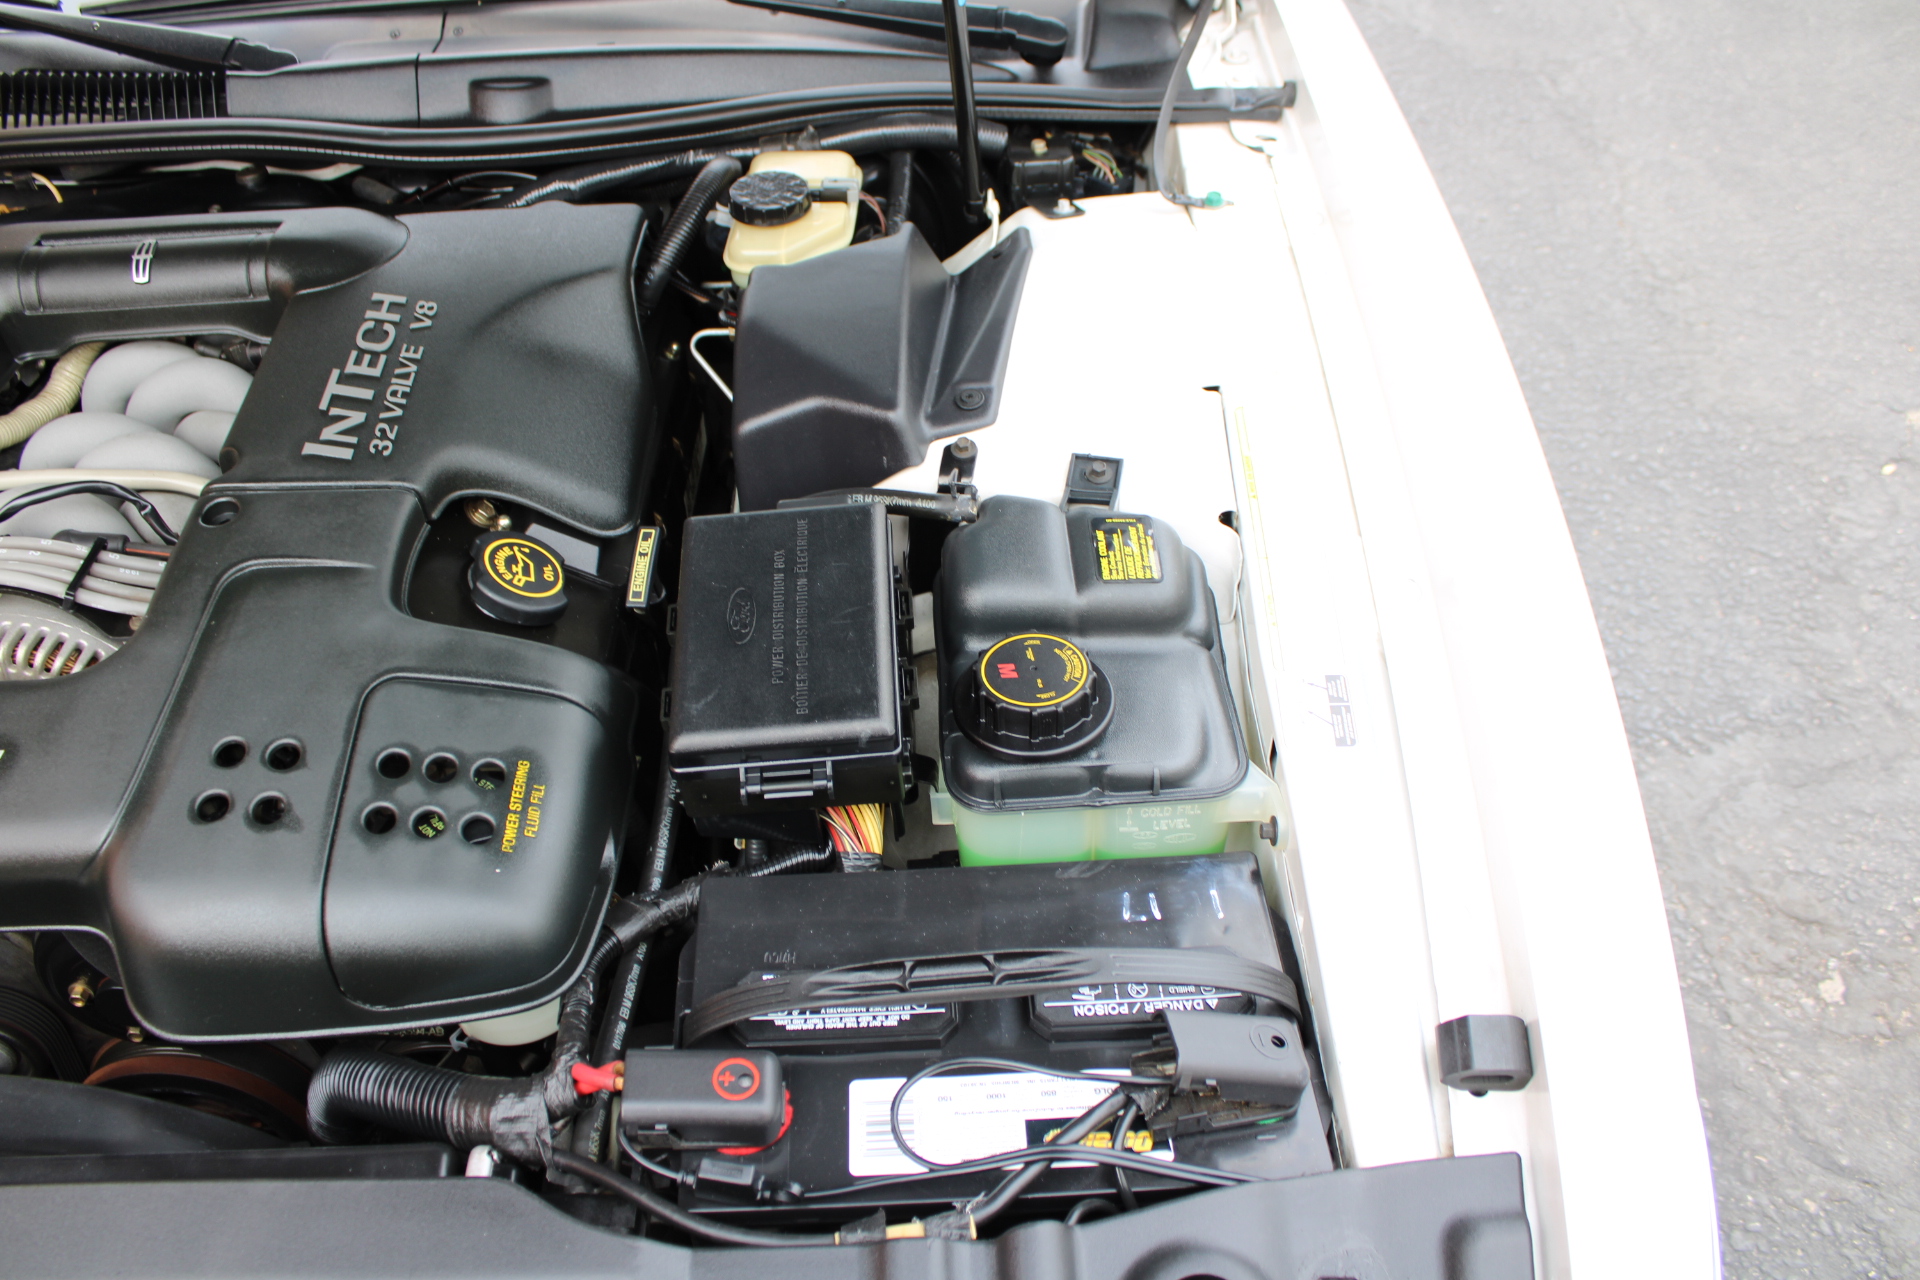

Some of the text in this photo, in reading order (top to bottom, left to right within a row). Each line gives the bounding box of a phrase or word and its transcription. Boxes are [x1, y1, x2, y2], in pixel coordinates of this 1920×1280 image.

[369, 300, 438, 456] 32 VALVE V8
[494, 545, 555, 582] ENGINE OIL
[633, 538, 651, 592] ENGINE OIL
[772, 549, 786, 684] POWER DISTRIBUTION BOX
[501, 760, 530, 853] POWER STEERING
[524, 784, 546, 838] FLUID FILL
[1141, 804, 1201, 818] COLD FILL
[1153, 818, 1191, 830] LEVEL
[1073, 1003, 1129, 1017] POISON
[1144, 999, 1204, 1014] DANGER
